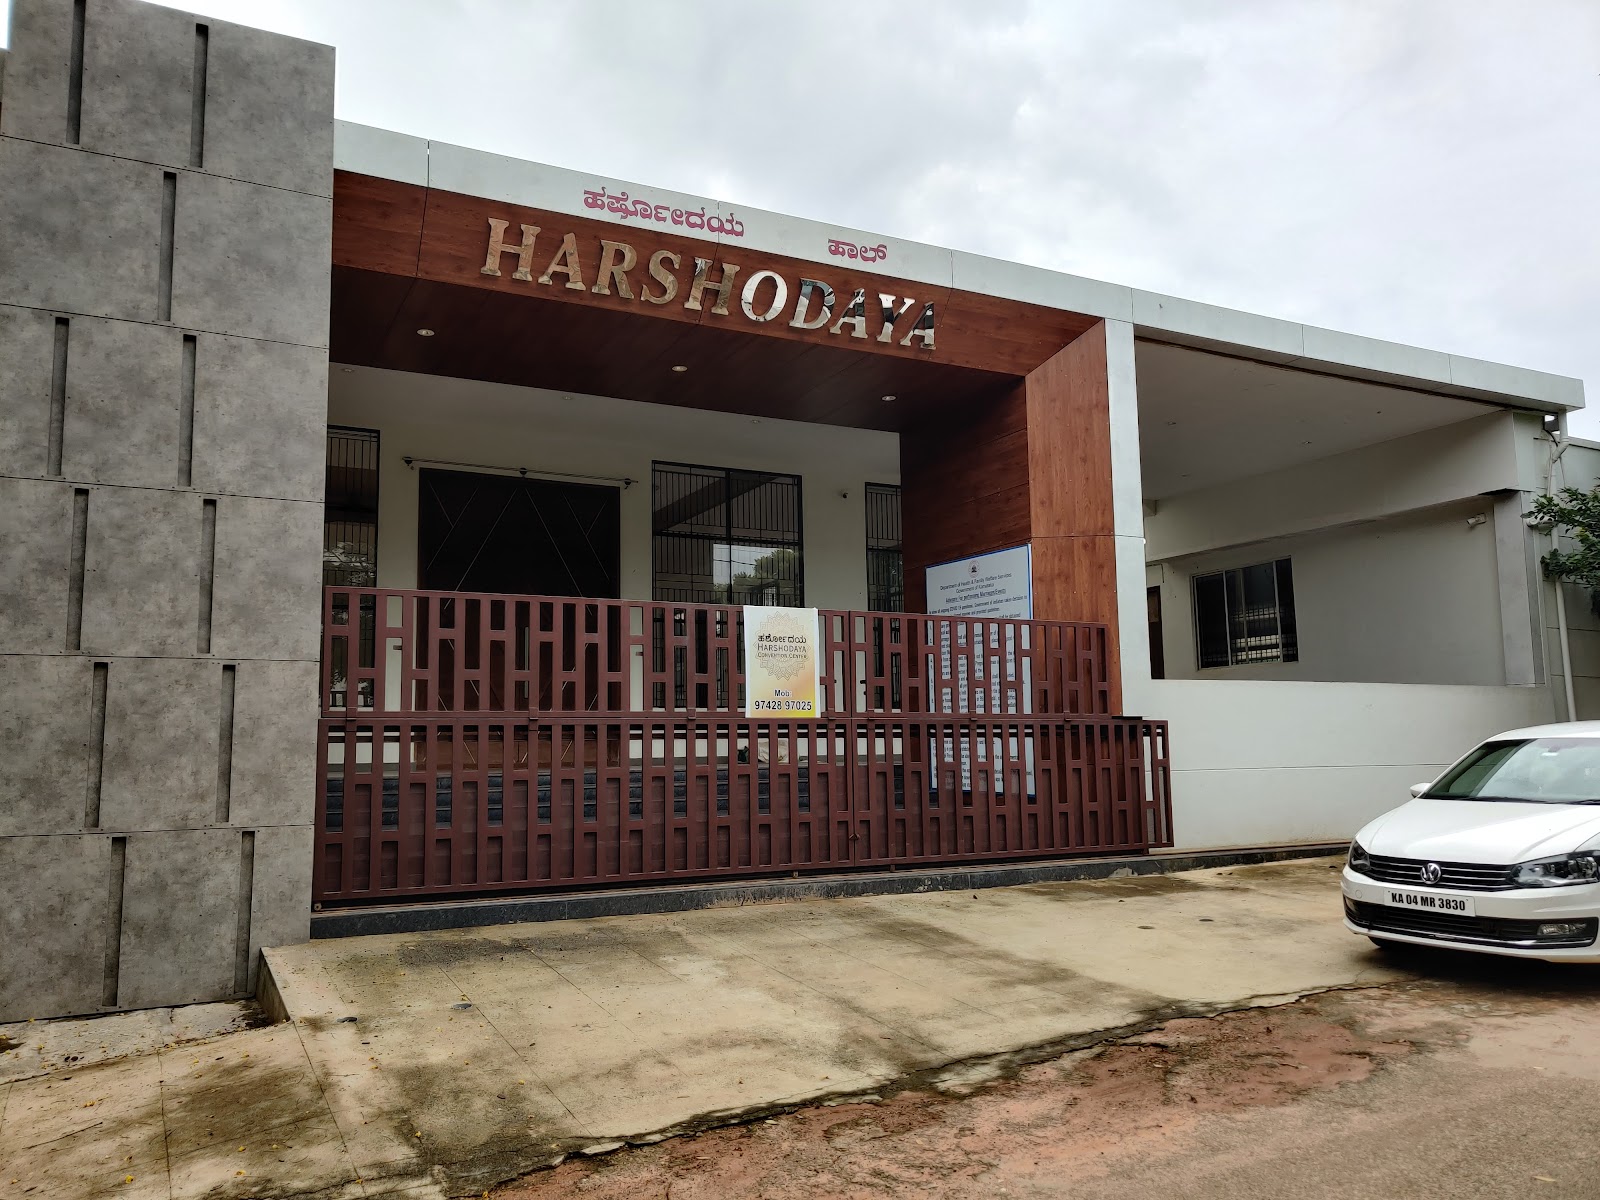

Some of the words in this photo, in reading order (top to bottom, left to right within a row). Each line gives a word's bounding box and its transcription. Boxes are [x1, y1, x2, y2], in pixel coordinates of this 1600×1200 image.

[828, 237, 887, 263] ಹಾಲ್
[480, 216, 937, 350] HARSHODAYA
[940, 583, 957, 591] Department
[757, 643, 807, 653] HARSHODAYA
[755, 701, 782, 710] 97428
[785, 701, 812, 710] 97025
[1391, 892, 1404, 903] KA
[1406, 894, 1419, 906] 04
[1420, 895, 1436, 908] MR
[1438, 897, 1466, 911] 3830
